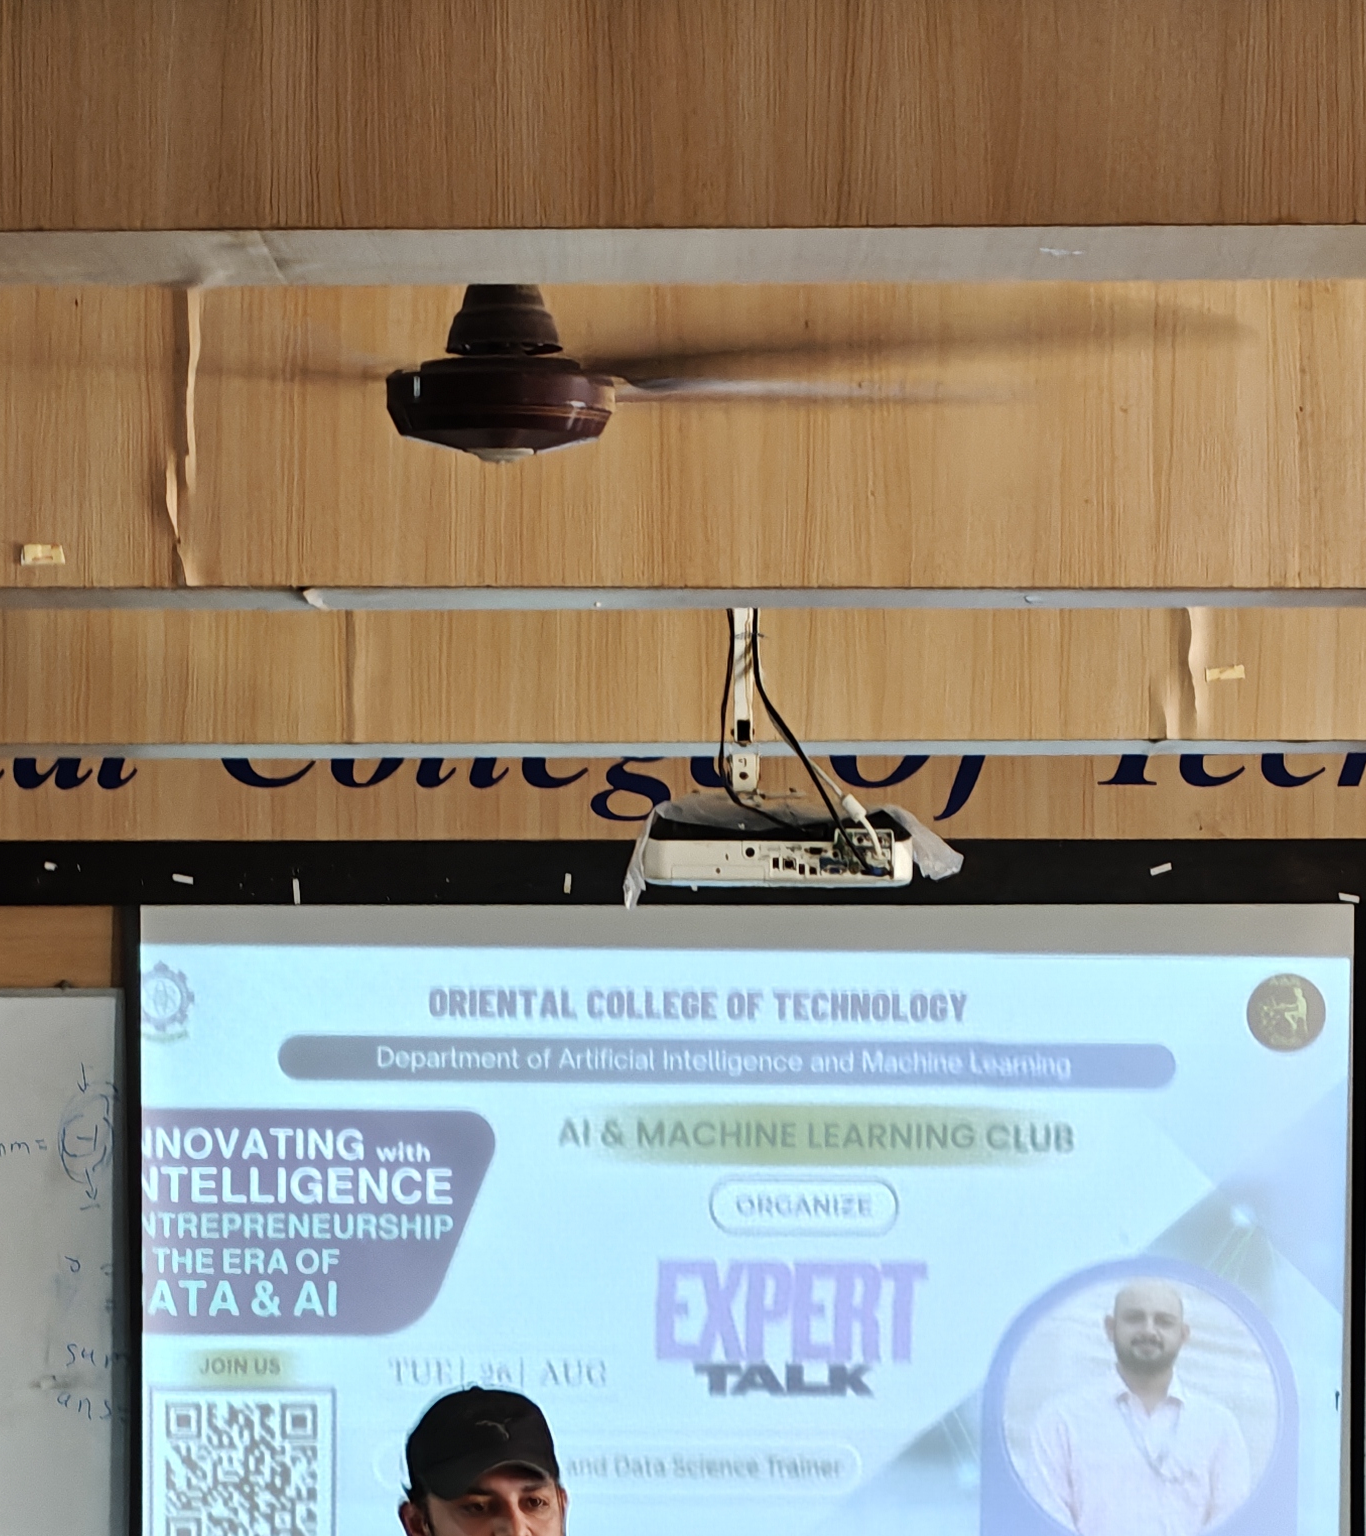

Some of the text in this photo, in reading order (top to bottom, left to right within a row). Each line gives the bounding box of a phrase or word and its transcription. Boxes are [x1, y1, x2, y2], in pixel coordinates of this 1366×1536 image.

[428, 987, 968, 1023] ORIENTAL COLLEGE OF TECHNOLOGY
[376, 1045, 1072, 1080] Department of Artificial Intelligence and Machine Learning
[559, 1117, 1075, 1152] AI & MACHINE LEARNING CLUB
[376, 1141, 430, 1163] with
[736, 1194, 873, 1217] ORGANIZE
[152, 1247, 340, 1274] THE ERA OF
[251, 1280, 281, 1317] &
[293, 1281, 339, 1317] AI
[655, 1259, 929, 1363] EXPERT
[200, 1358, 281, 1375] JOIN US
[543, 1358, 606, 1386] AUG
[694, 1362, 875, 1397] TALK
[567, 1456, 843, 1480] and Data Science Trainer
